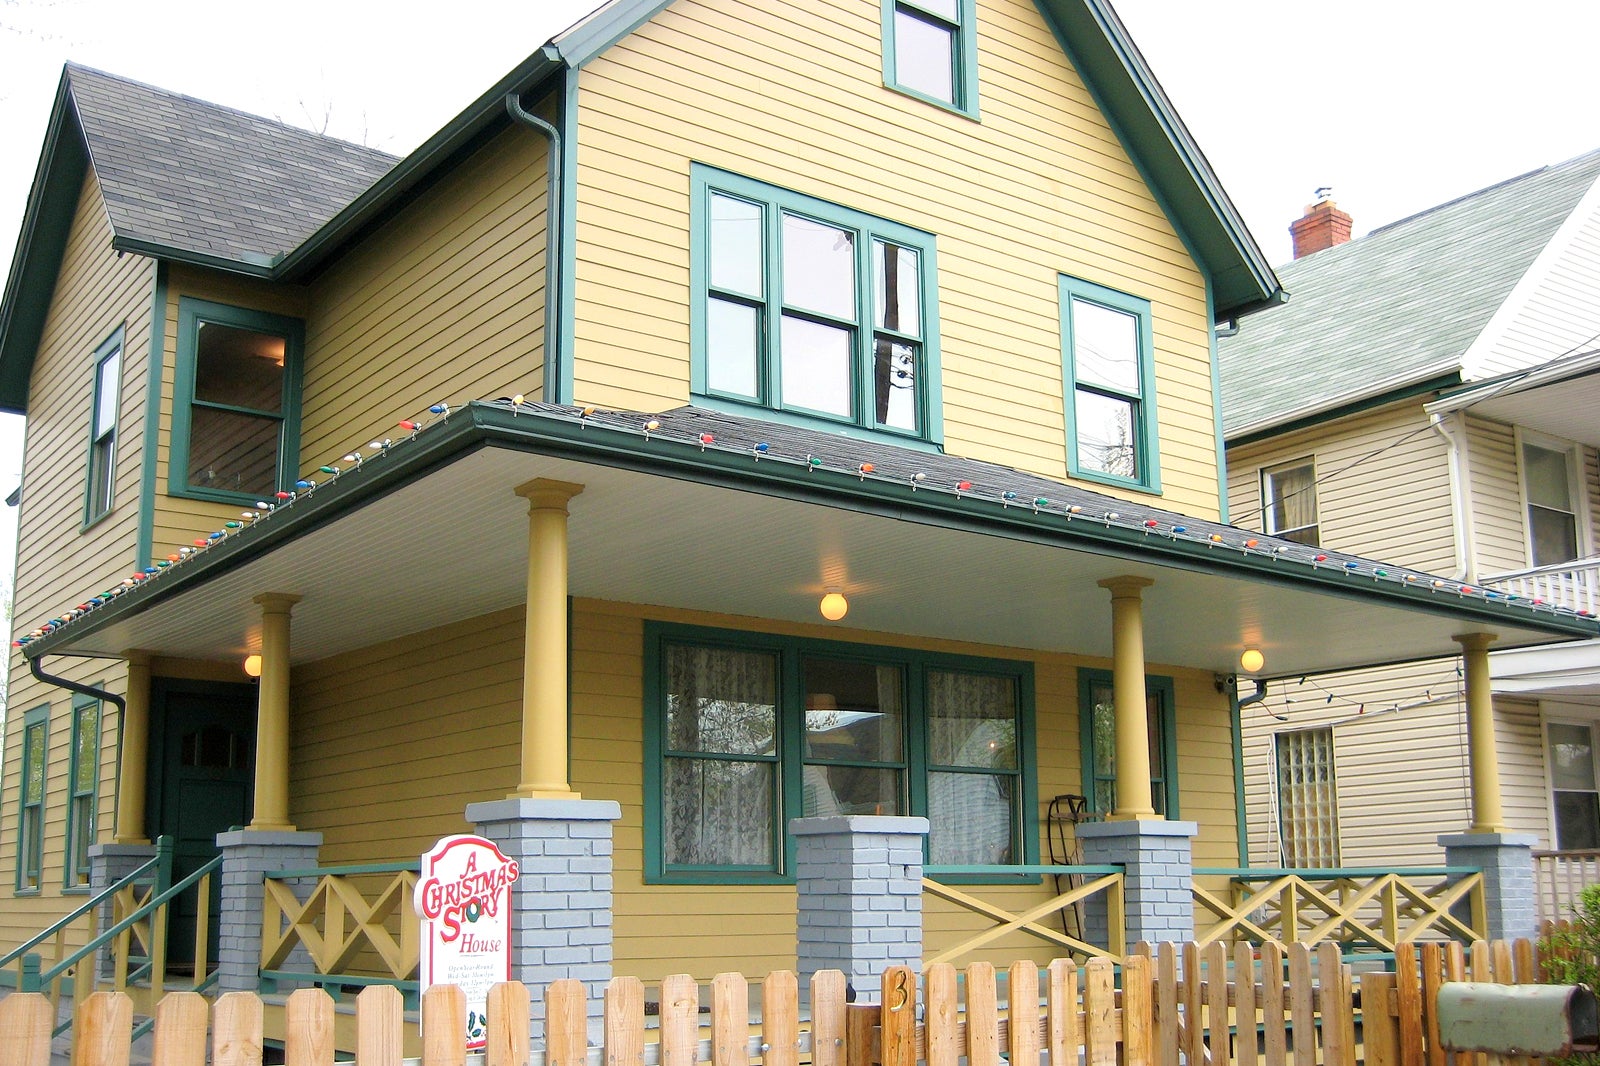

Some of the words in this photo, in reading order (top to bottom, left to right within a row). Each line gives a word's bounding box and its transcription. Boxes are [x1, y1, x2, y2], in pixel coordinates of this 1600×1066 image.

[460, 851, 477, 879] A
[422, 862, 518, 919] CHRISTMAS
[440, 886, 503, 943] STORY
[459, 933, 501, 953] House
[890, 970, 908, 1012] 3
